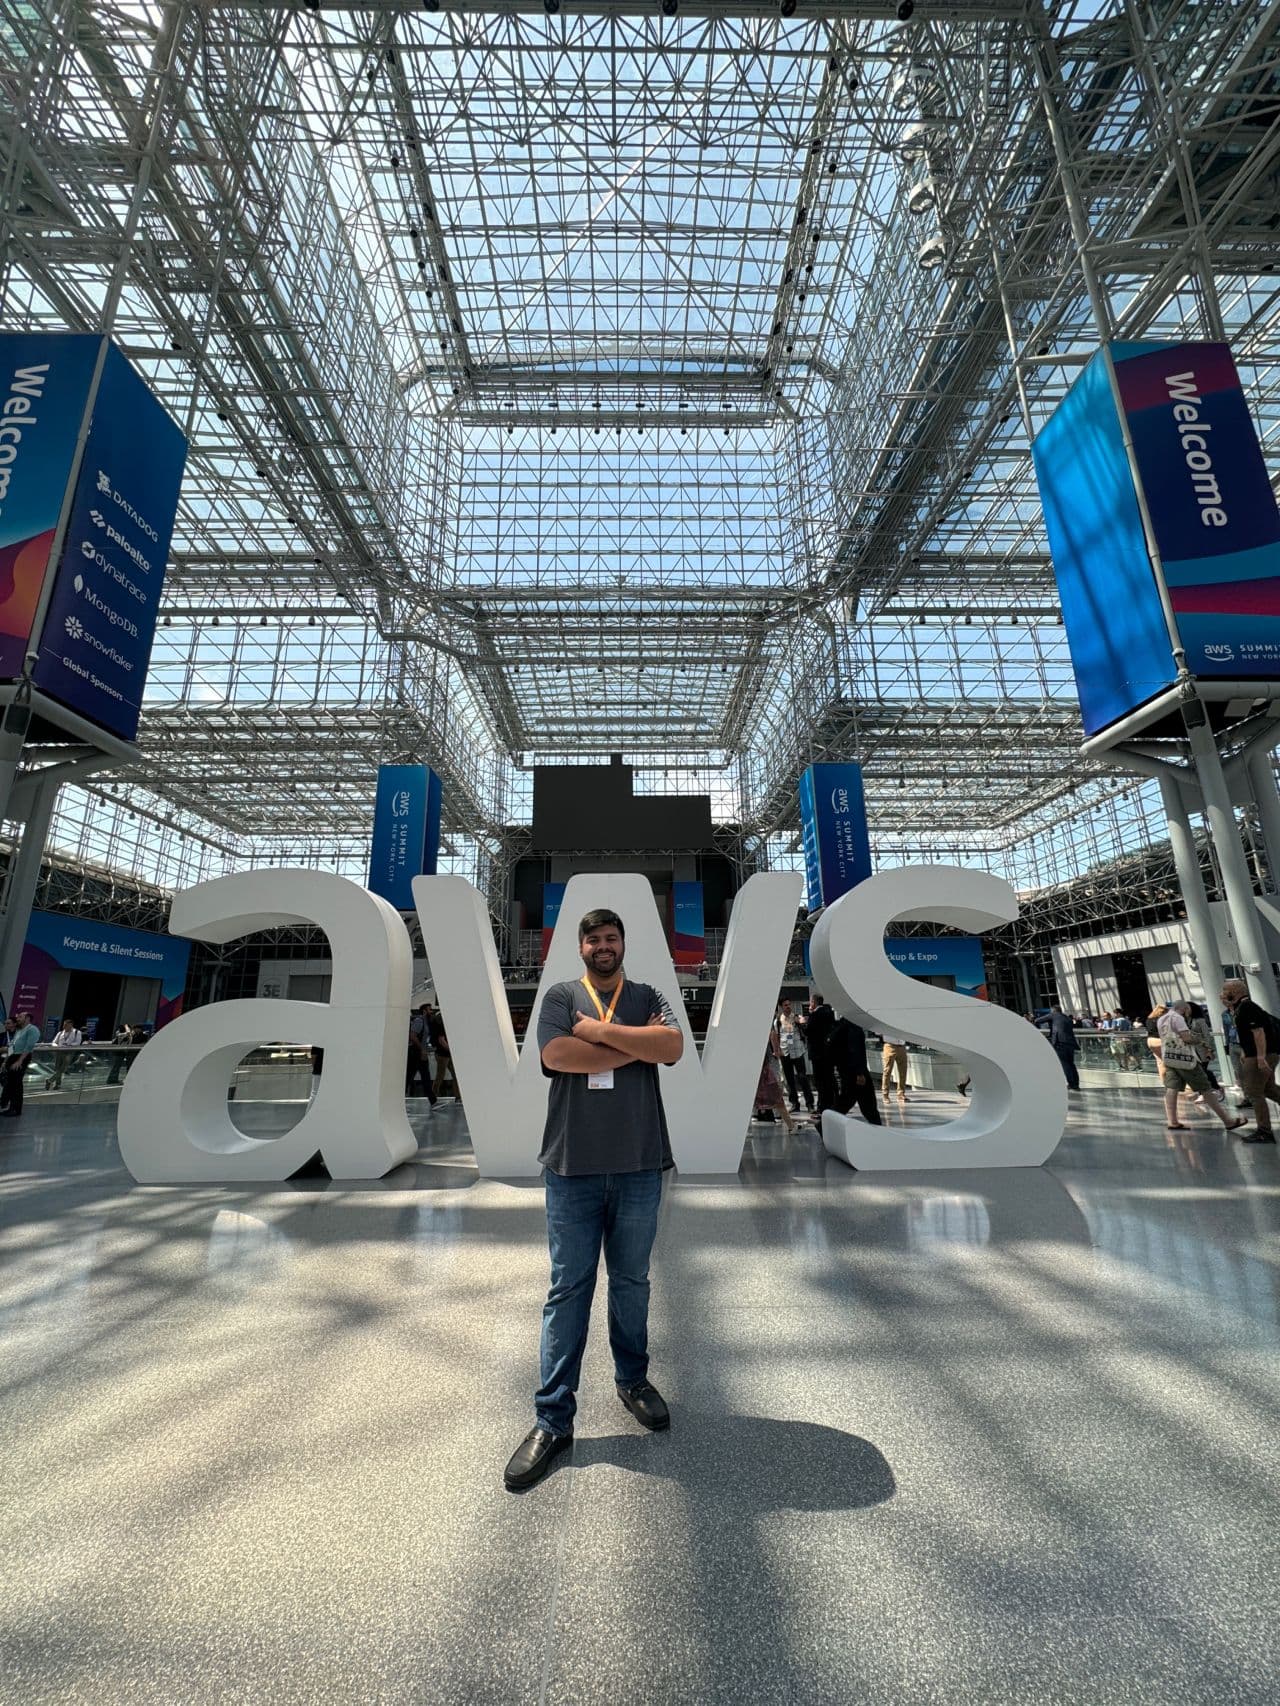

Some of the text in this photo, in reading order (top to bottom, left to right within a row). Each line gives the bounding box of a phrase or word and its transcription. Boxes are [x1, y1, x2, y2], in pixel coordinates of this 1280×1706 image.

[1165, 371, 1228, 527] Welcome
[113, 490, 159, 543] DATADOG
[106, 524, 151, 572] paloalto
[95, 552, 148, 605] dynatrace
[83, 631, 133, 672] snowflake
[1239, 643, 1280, 652] SUMMI
[62, 657, 124, 702] Global Sponsors
[398, 824, 408, 866] SUMMIT
[843, 820, 854, 862] SUMMIT
[63, 936, 164, 961] Keynote & Silent Sessions
[908, 952, 916, 961] &
[917, 952, 938, 962] Expo
[263, 984, 281, 998] 3E
[117, 867, 1069, 1184] aws
